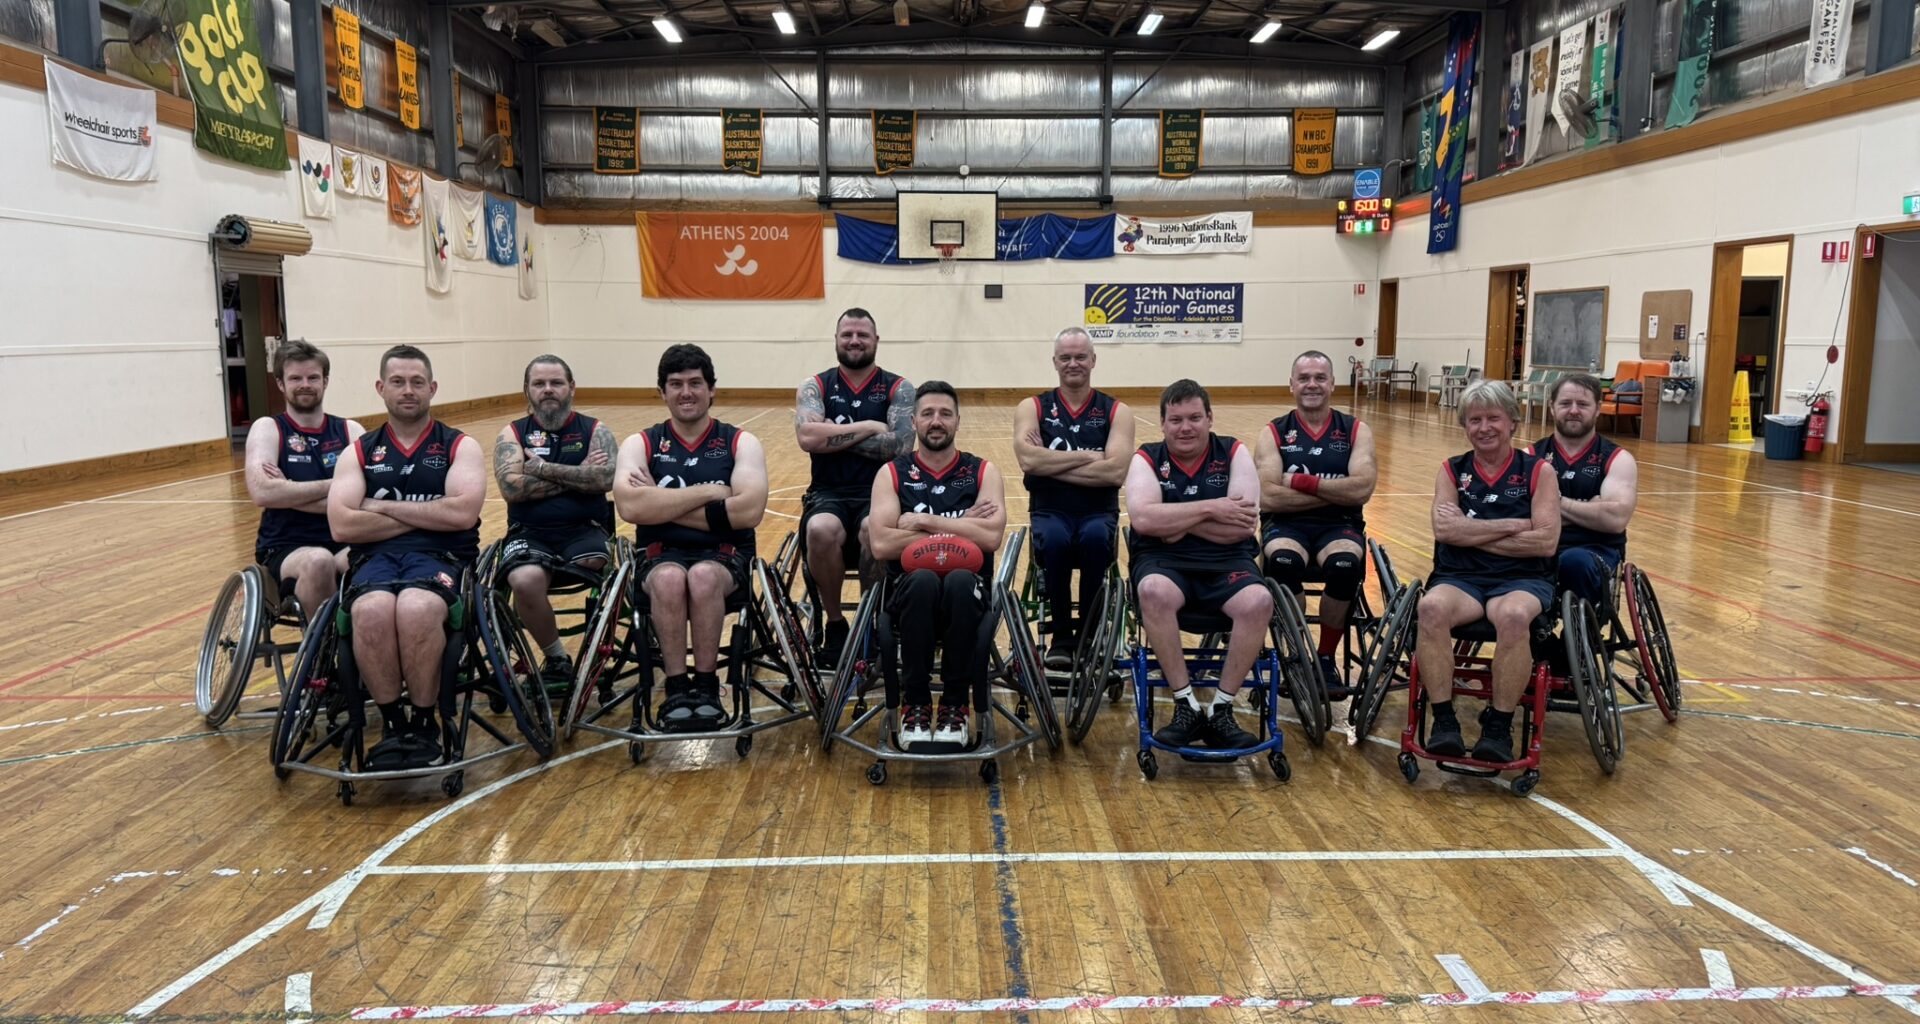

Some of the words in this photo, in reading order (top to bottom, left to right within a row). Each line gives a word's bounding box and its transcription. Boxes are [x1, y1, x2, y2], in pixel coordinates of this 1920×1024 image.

[64, 111, 110, 135] wheelchair
[111, 126, 138, 140] sports
[1303, 129, 1326, 141] NWBC
[1295, 143, 1332, 154] CHAMPIONS
[679, 225, 746, 241] ATHENS
[749, 225, 790, 241] 2004
[1159, 223, 1181, 234] 1996
[1181, 219, 1238, 233] NationsBank
[1146, 234, 1196, 247] Paralympic
[1198, 233, 1222, 244] Torch
[1223, 232, 1248, 245] Relay
[1134, 286, 1167, 300] 12th
[1173, 286, 1236, 300] National
[1133, 301, 1180, 315] Junior
[1186, 301, 1235, 315] Games
[1095, 330, 1112, 338] AMP
[1116, 329, 1160, 338] foundation
[912, 542, 970, 560] SHERRIN
